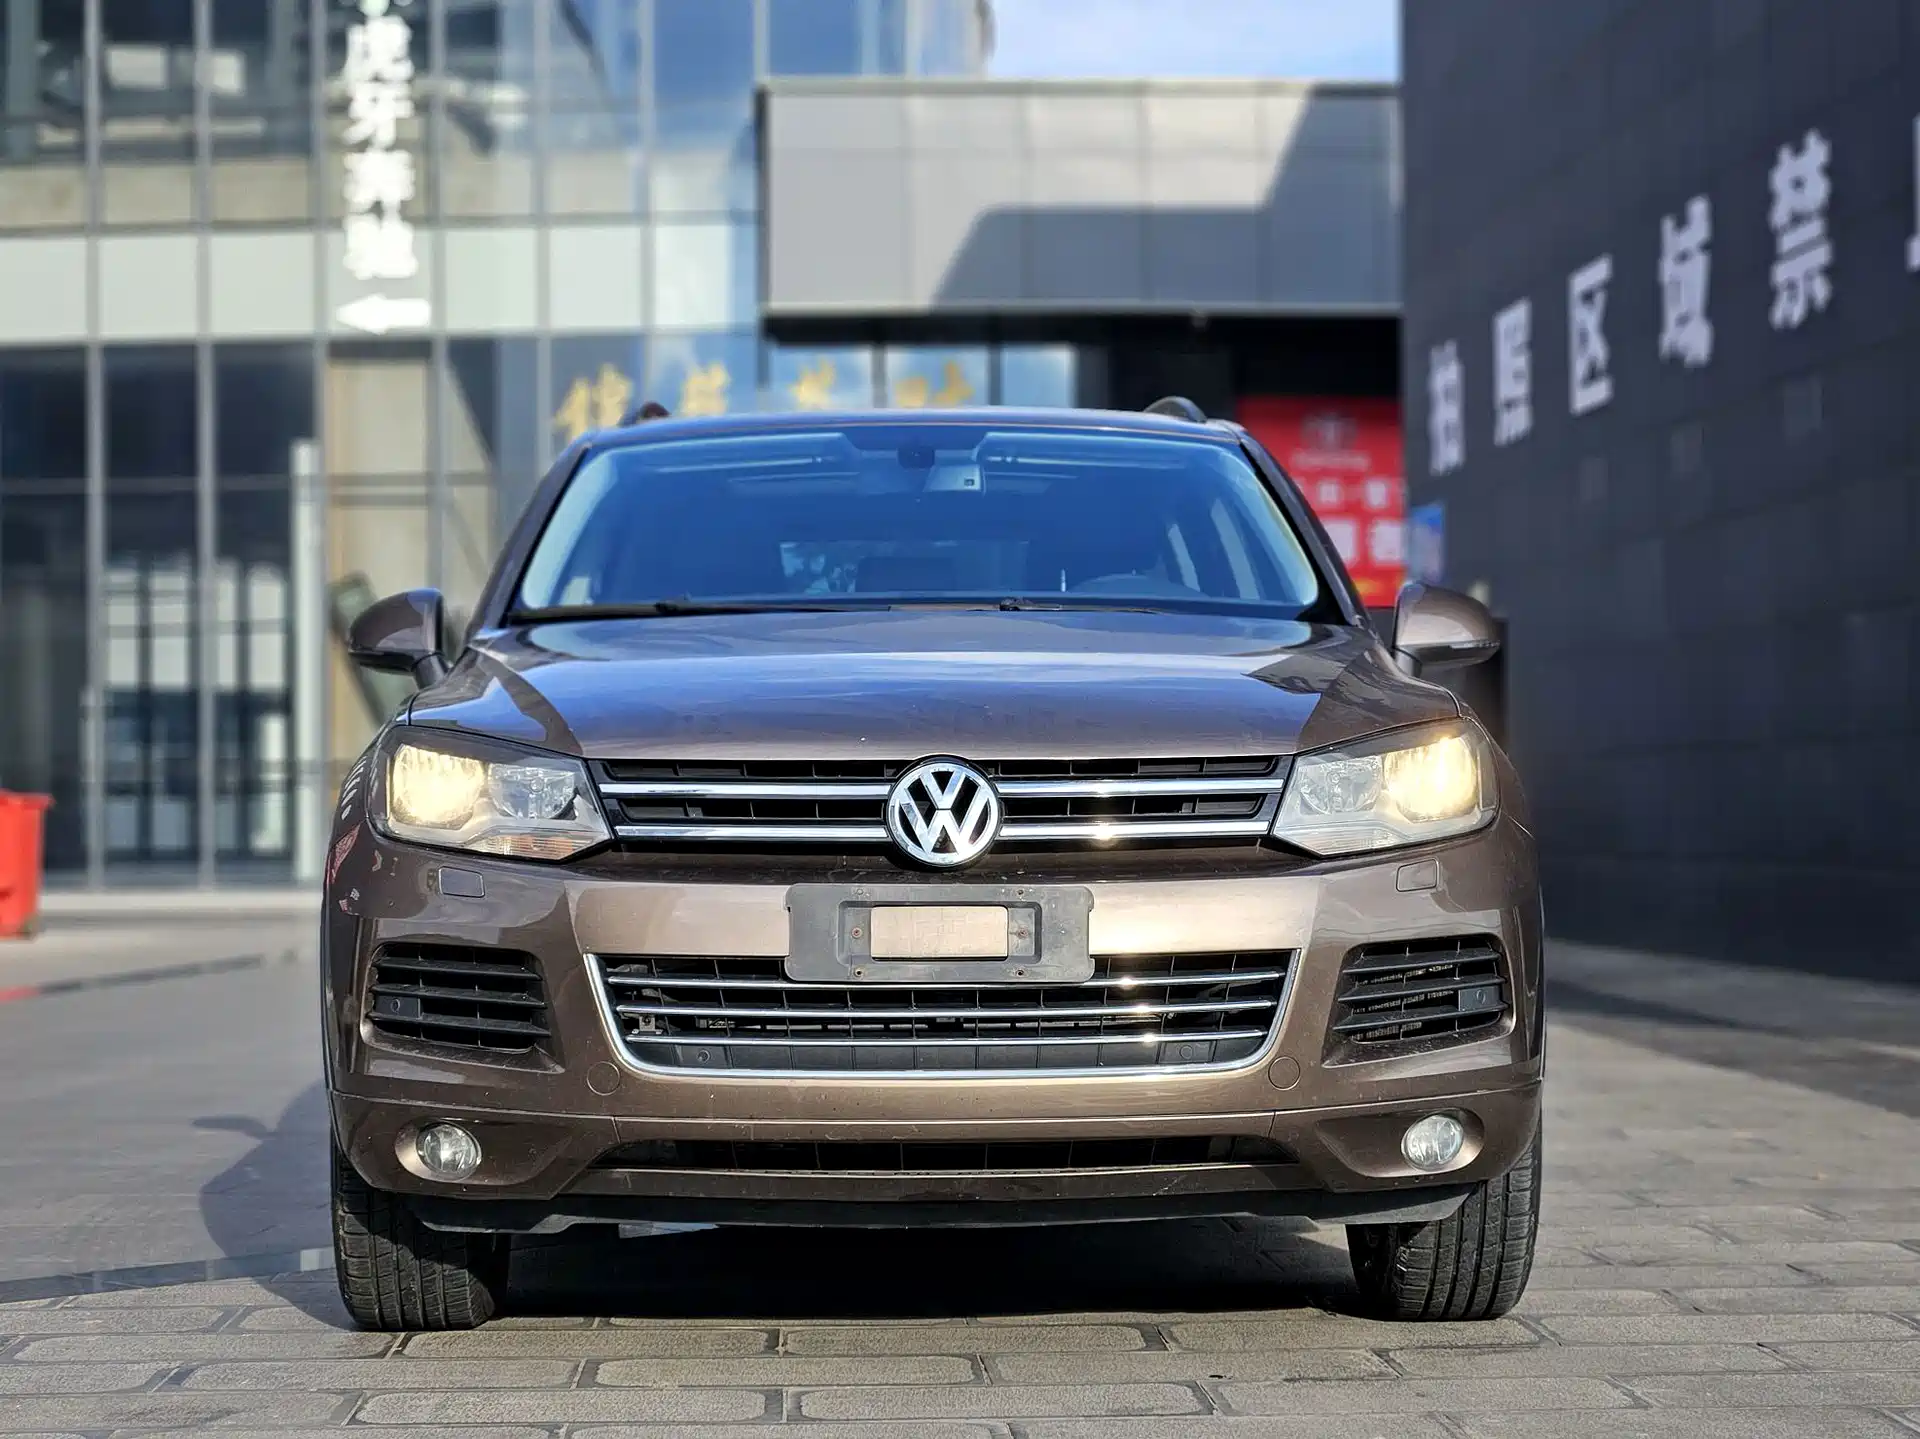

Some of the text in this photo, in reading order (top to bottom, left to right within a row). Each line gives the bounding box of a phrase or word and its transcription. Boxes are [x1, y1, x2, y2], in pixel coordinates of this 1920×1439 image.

[1427, 113, 1920, 477] 拍照区域禁
[890, 763, 997, 862] VW
